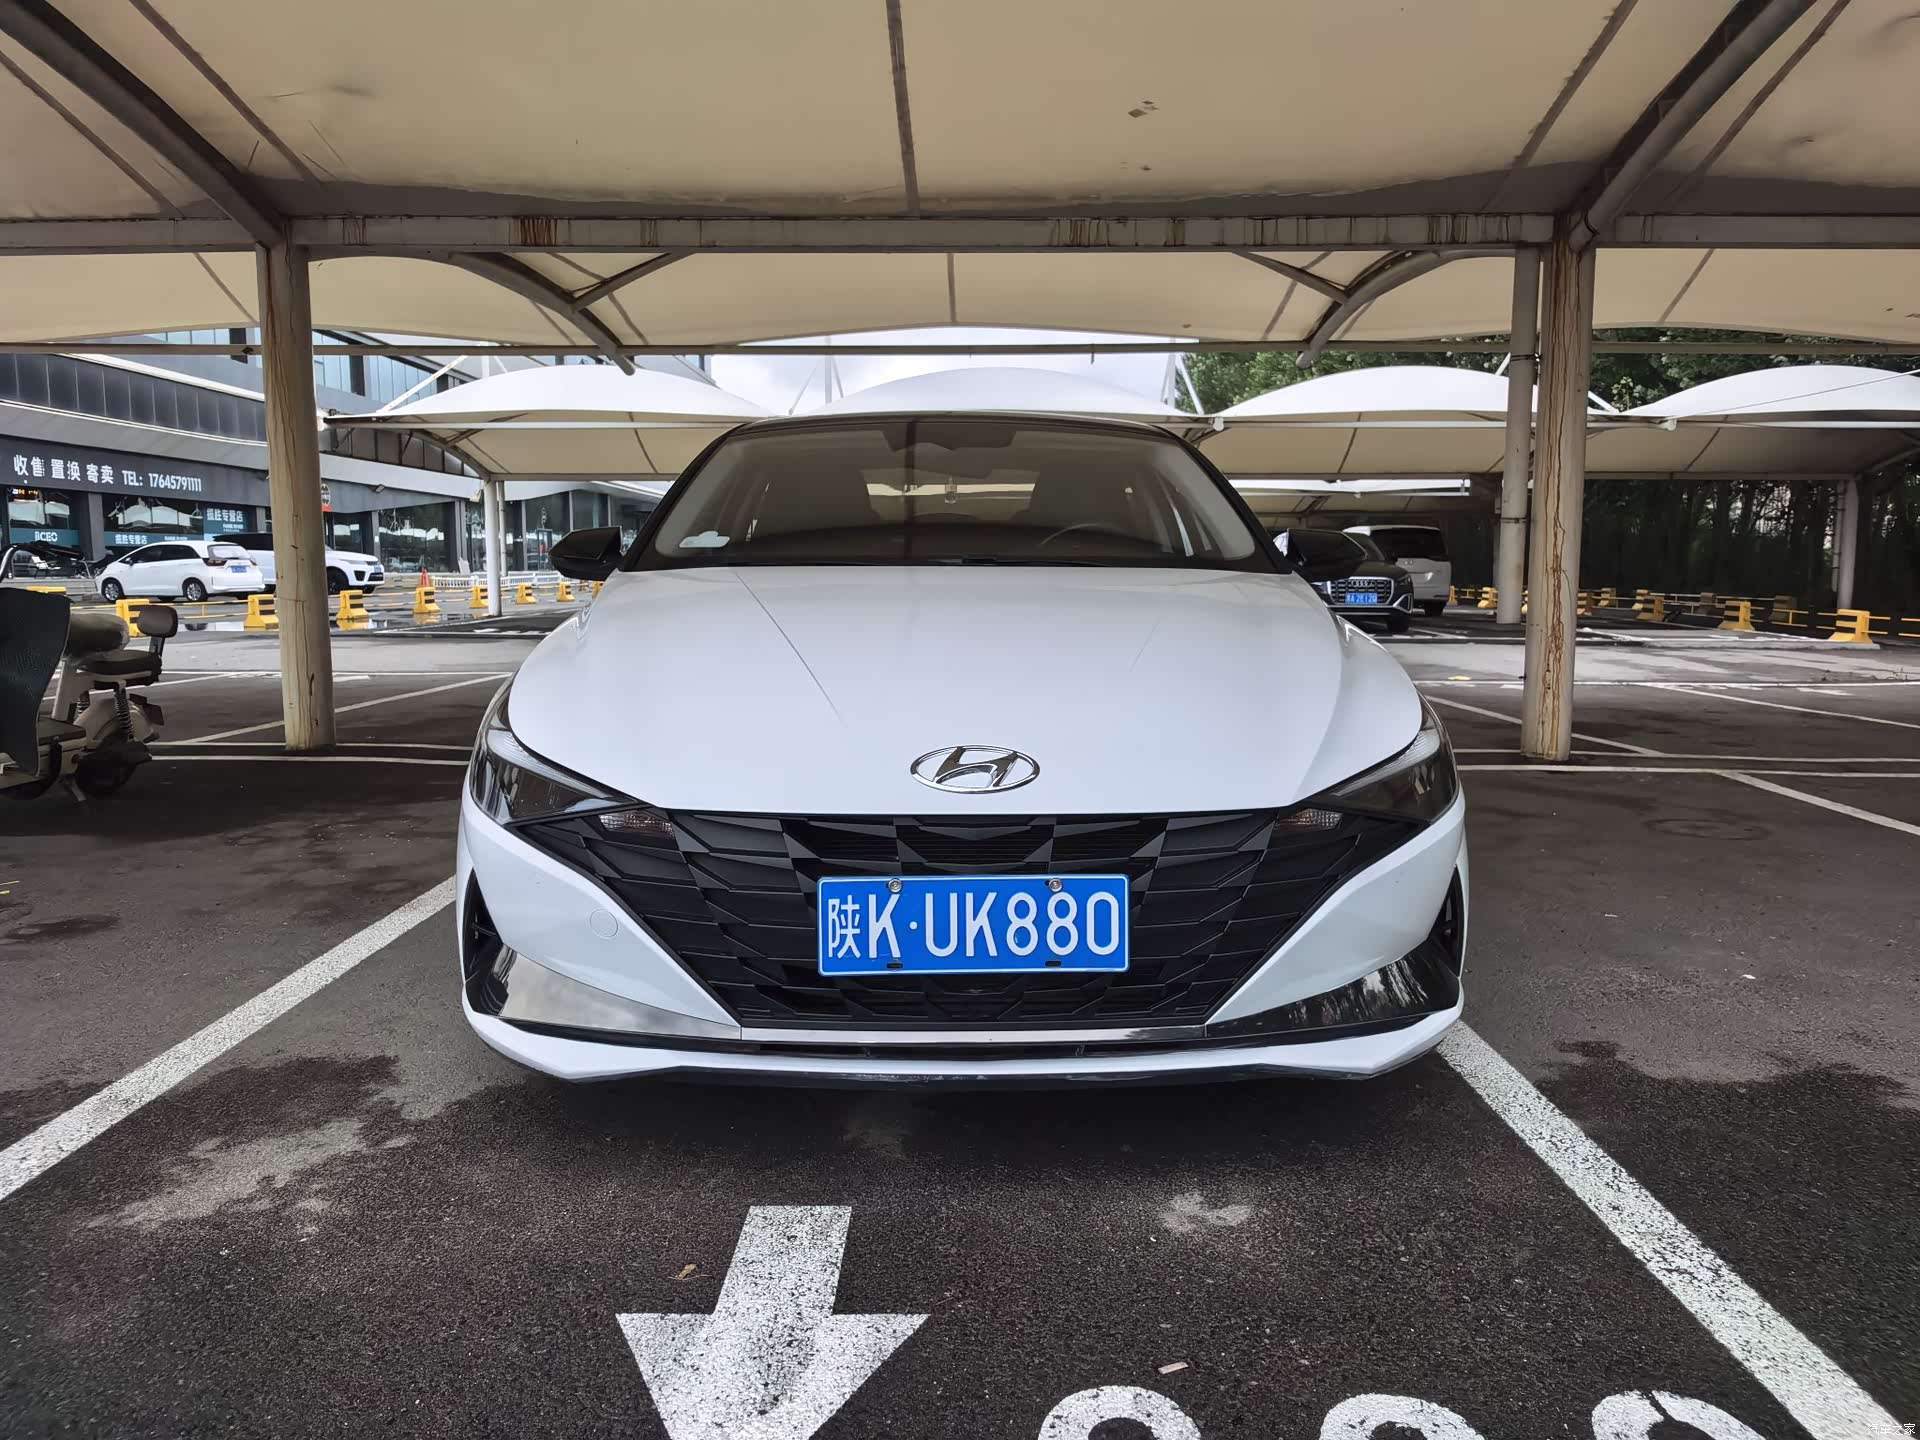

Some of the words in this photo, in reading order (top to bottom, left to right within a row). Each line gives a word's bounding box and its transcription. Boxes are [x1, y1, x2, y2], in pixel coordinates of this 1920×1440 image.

[50, 458, 81, 482] 置换
[86, 463, 115, 484] 寄卖
[121, 470, 144, 487] TEL:
[148, 472, 202, 492] 17645791111
[828, 891, 1120, 959] 陕K·UK880
